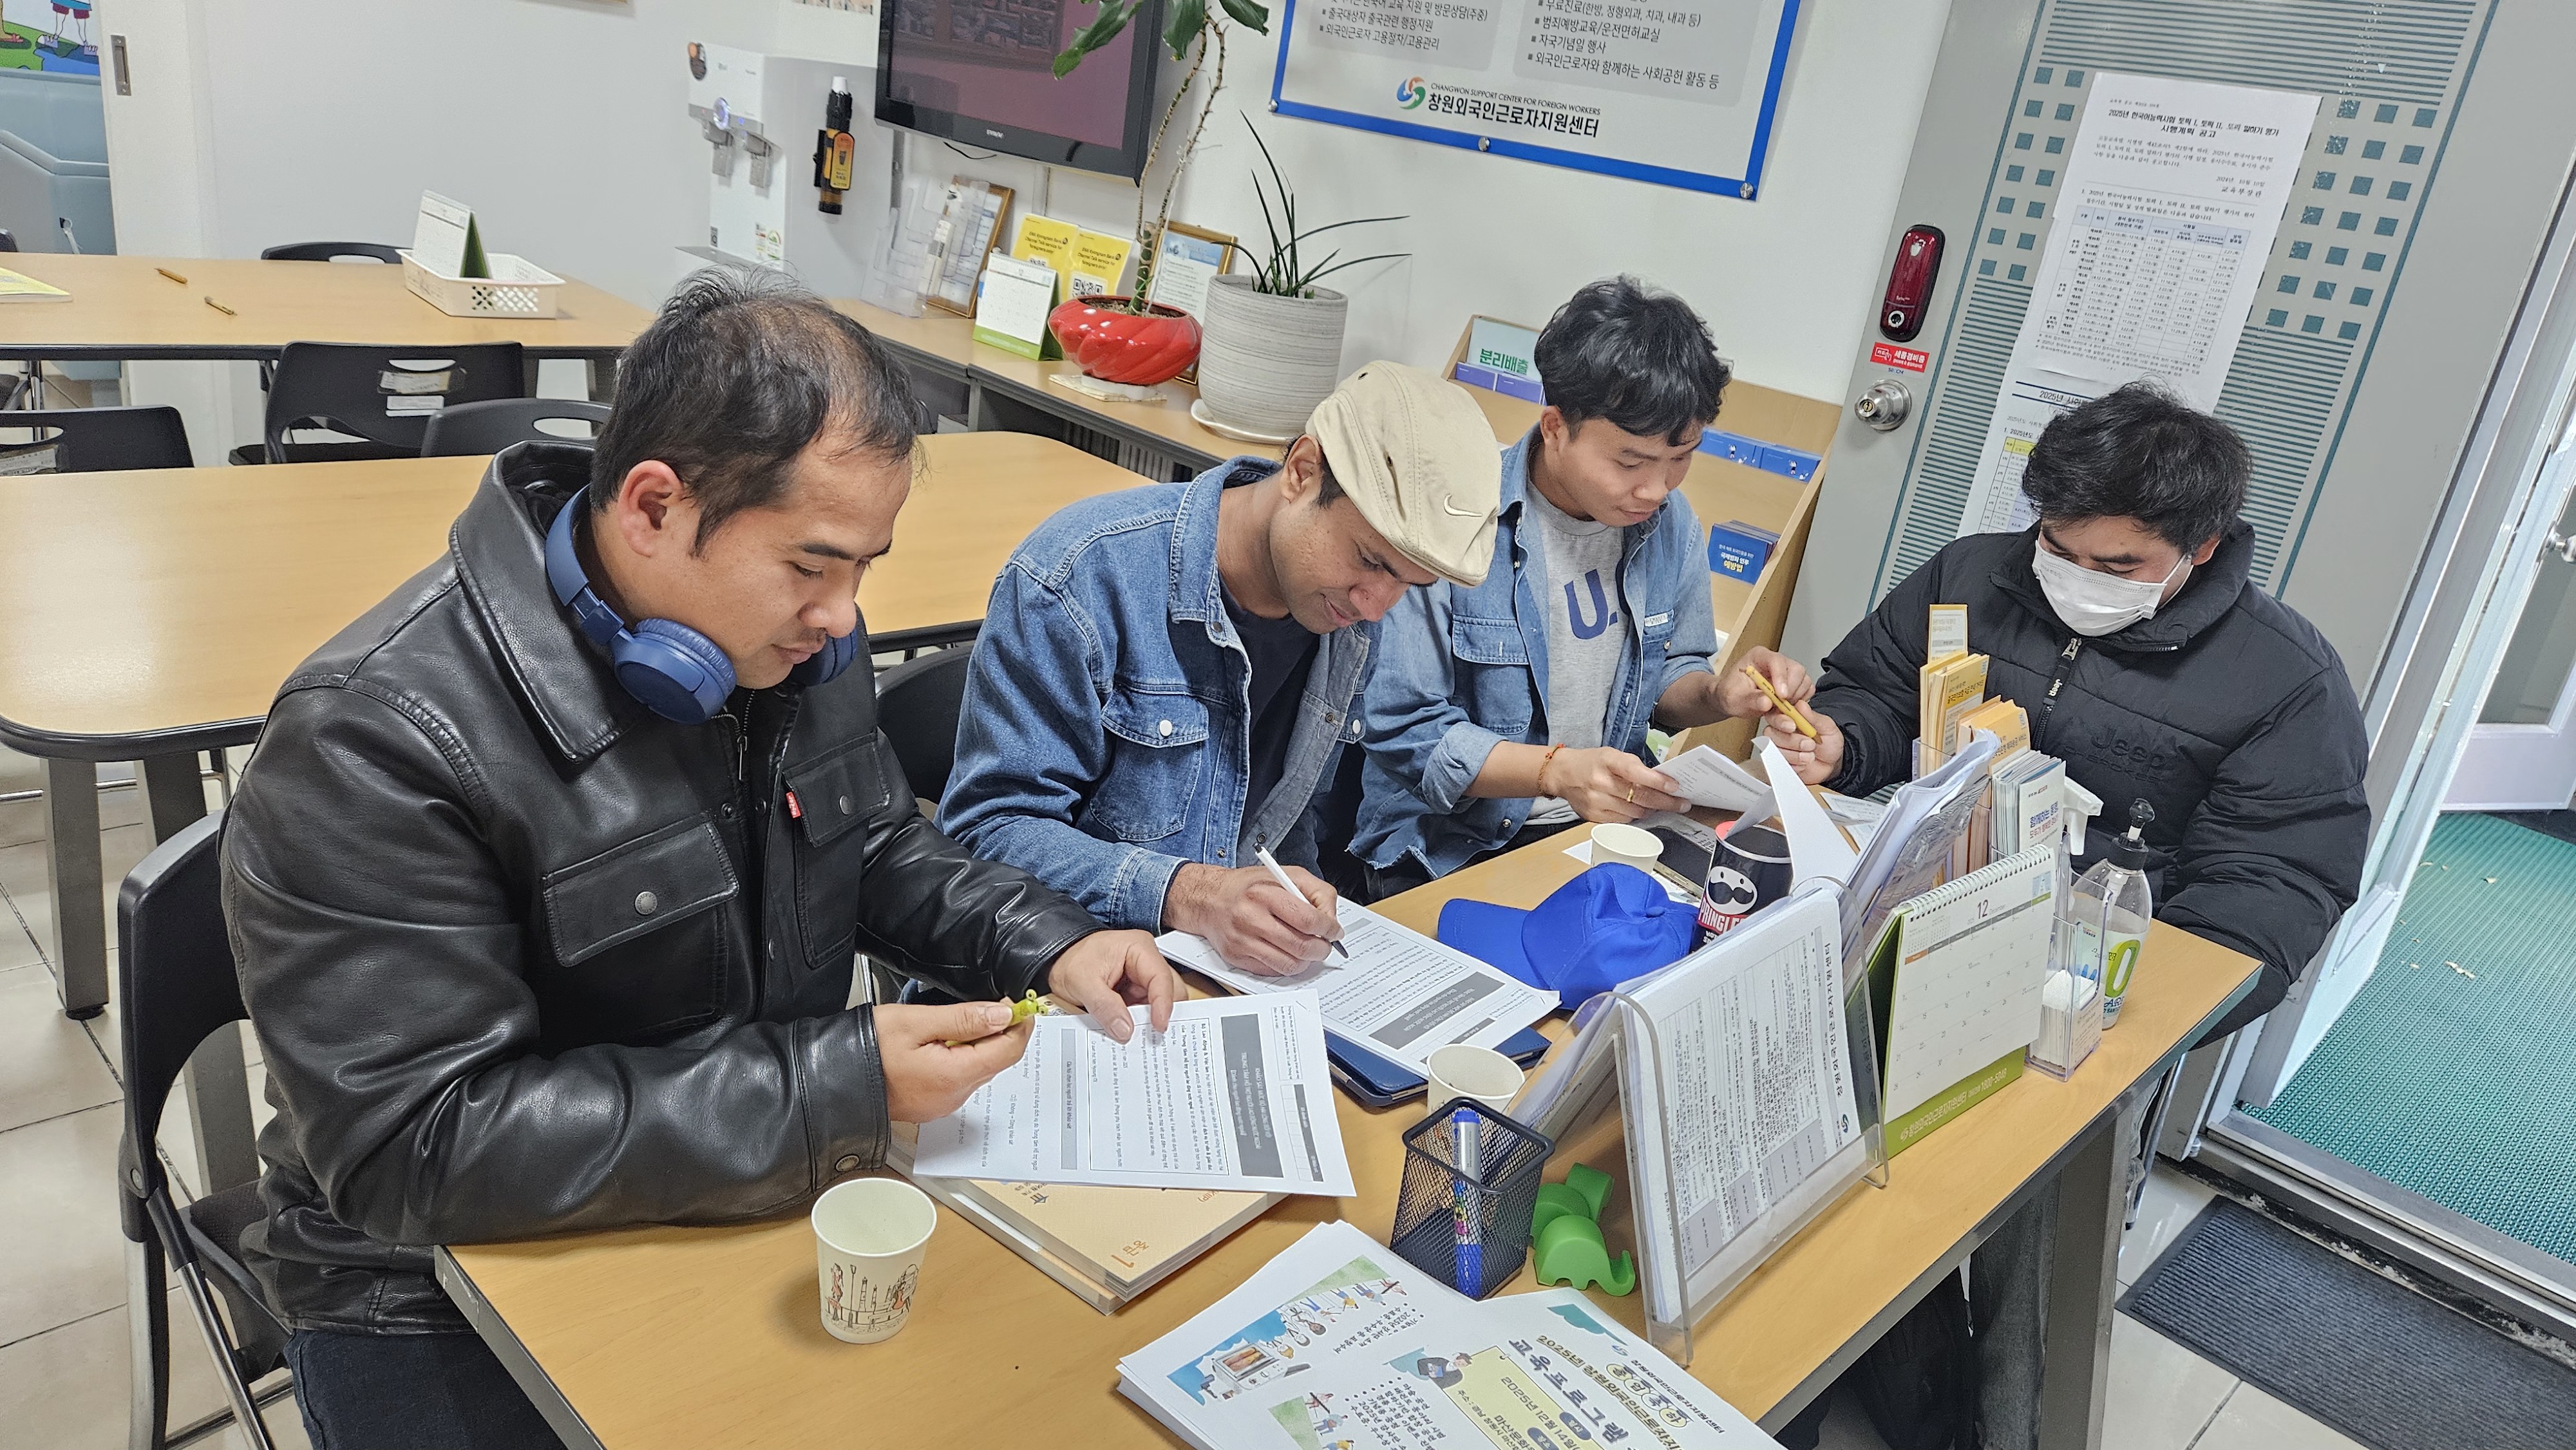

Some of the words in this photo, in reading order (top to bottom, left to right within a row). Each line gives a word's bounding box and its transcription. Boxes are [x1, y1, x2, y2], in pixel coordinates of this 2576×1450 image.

[1327, 7, 1366, 23] 출국대상자
[1367, 12, 1399, 28] 출국관련
[1400, 16, 1433, 32] 행정지원
[1406, 0, 1422, 13] 지원
[1424, 1, 1432, 14] 및
[1434, 2, 1488, 23] 방문상담(주중)
[1606, 4, 1643, 21] 정형외과,
[1645, 8, 1665, 23] 치과,
[1667, 11, 1685, 26] 내과
[1688, 12, 1701, 28] 등)
[1325, 24, 1371, 41] 외국인근로자
[1372, 29, 1439, 51] 고용절차/고용관리
[1542, 12, 1660, 44] 범죄예방교육/운전면허교실
[1537, 32, 1585, 52] 자국기념일
[1587, 39, 1607, 55] 행사
[1535, 50, 1600, 73] 외국인근로자와
[1601, 60, 1640, 79] 함께하는
[1642, 64, 1683, 84] 사회공헌
[1685, 70, 1706, 88] 활동
[1709, 74, 1719, 89] 등
[1430, 82, 1470, 95] CHANGWON
[1470, 89, 1497, 99] SUPPORT
[1498, 93, 1522, 103] CENTER
[1523, 97, 1537, 106] FOR
[1537, 99, 1567, 110] FOREIGN
[1568, 104, 1600, 115] WORKERS
[2108, 108, 2129, 118] 2025년
[1427, 92, 1598, 137] 창원외국인근로자지원센터
[1478, 348, 1530, 375] 분리배출
[2039, 390, 2063, 402] 2025년
[2010, 429, 2033, 438] 2025년도
[2049, 679, 2063, 696] Jeep
[2090, 722, 2166, 767] Jeep
[1698, 896, 1739, 932] PRINGLE
[1978, 899, 1989, 919] 12
[1823, 943, 1843, 1098] 창원외국인근로자지원센터
[1909, 1091, 1967, 1137] 창원외국인근로자지원센터
[1111, 1255, 1135, 1268] 1
[1356, 1329, 1365, 1339] 등
[1370, 1324, 1390, 1341] 강사단
[1387, 1310, 1411, 1329] 2025년
[1358, 1336, 1372, 1348] 소개
[1402, 1381, 1417, 1398] 마술
[1414, 1395, 1430, 1411] 공연
[1501, 1377, 1537, 1409] 2025년
[1535, 1410, 1558, 1430] 12월
[1509, 1339, 1629, 1443] 교육프로그램
[1536, 1335, 1585, 1368] 2025년
[1582, 1365, 1683, 1450] 창원외국인근로자지
[1630, 1359, 1726, 1434] 창원외국인근로자지원센터
[1349, 1402, 1372, 1427] 수료증,
[1369, 1423, 1392, 1448] 우수상
[1358, 1398, 1382, 1426] 2025년
[1379, 1422, 1401, 1445] 강사단
[1367, 1395, 1387, 1417] 기념품
[1383, 1413, 1399, 1431] 증정
[1387, 1403, 1403, 1421] 추첨
[1400, 1418, 1421, 1440] 이벤트
[1394, 1384, 1413, 1406] 태권도
[1410, 1402, 1433, 1427] 동아리
[1430, 1424, 1446, 1440] 시범
[1457, 1388, 1471, 1403] 주소
[1483, 1415, 1503, 1437] 창원시
[1568, 1418, 1584, 1435] 일시
[1420, 1426, 1436, 1444] 공연
